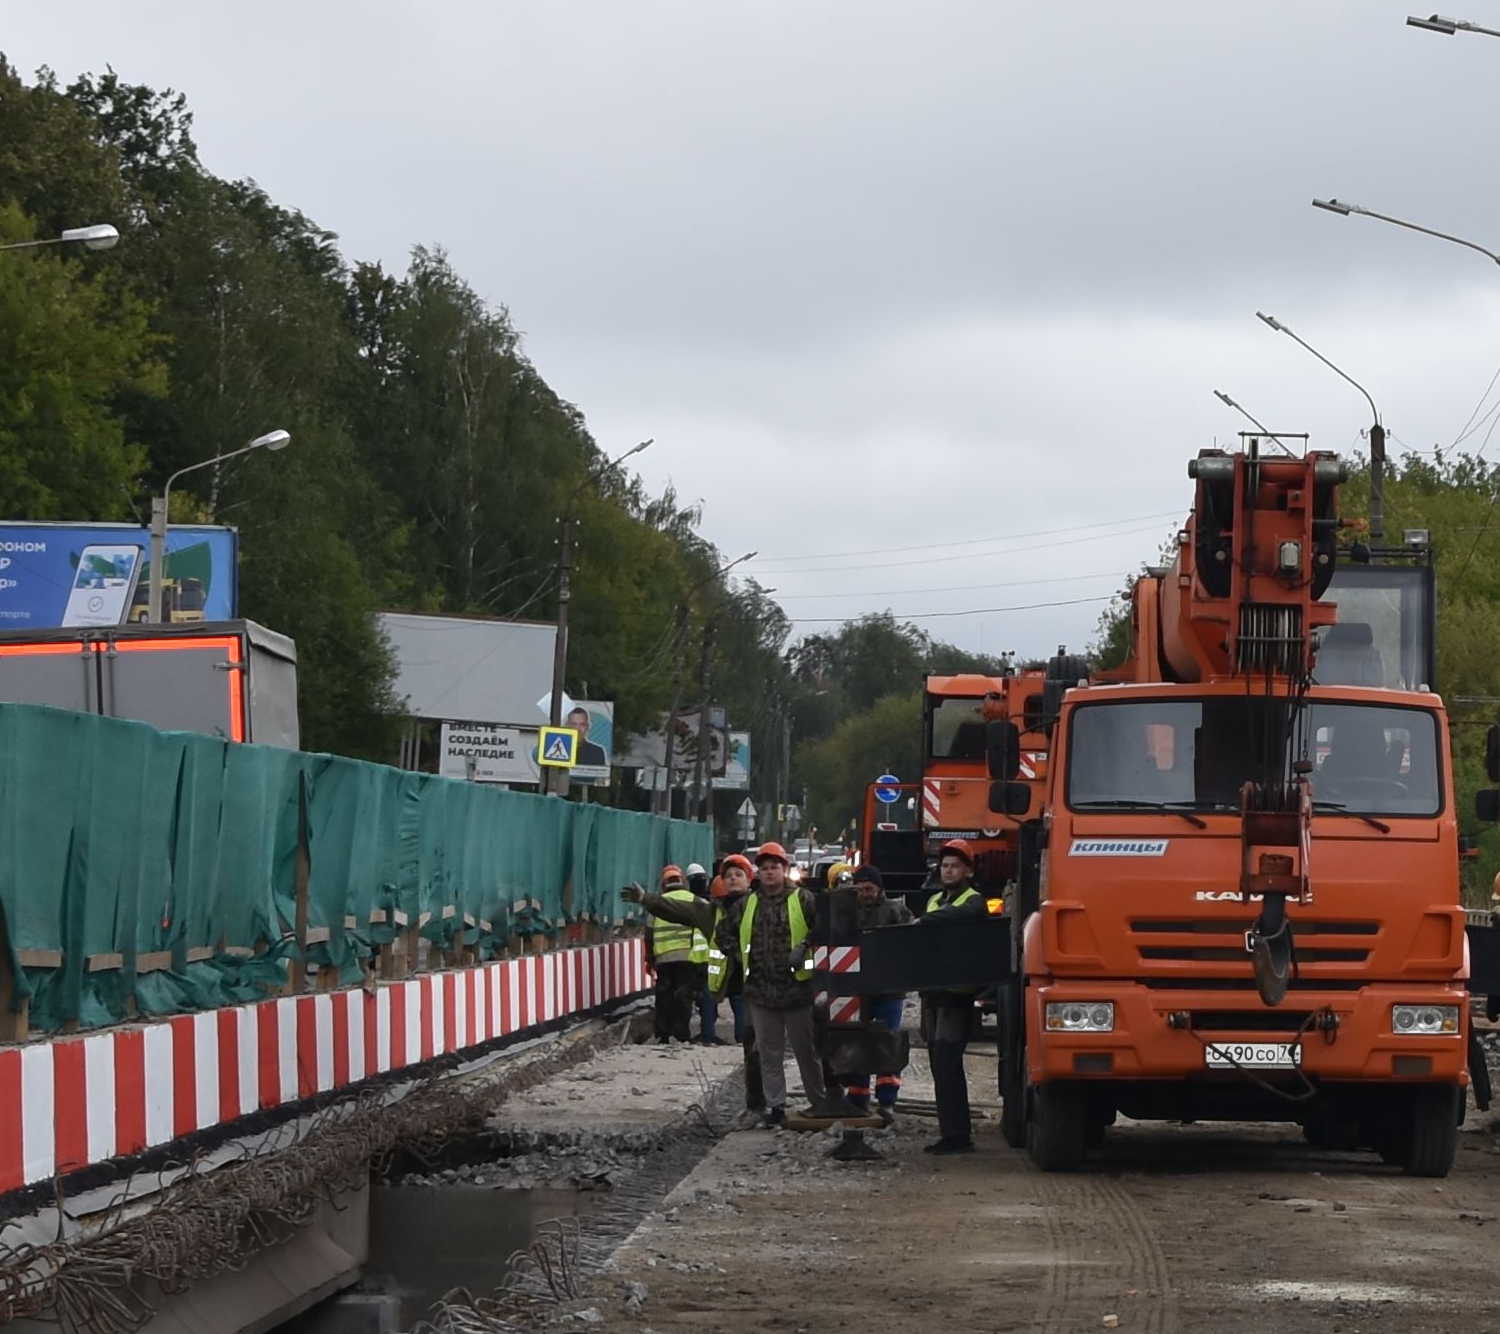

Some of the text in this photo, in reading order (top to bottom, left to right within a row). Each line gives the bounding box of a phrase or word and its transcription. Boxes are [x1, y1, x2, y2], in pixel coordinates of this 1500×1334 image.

[448, 734, 508, 747] СОЗДАЁМ
[448, 748, 515, 760] НАСЛЕДИЕ
[1074, 842, 1164, 853] КЛИНЦЫ
